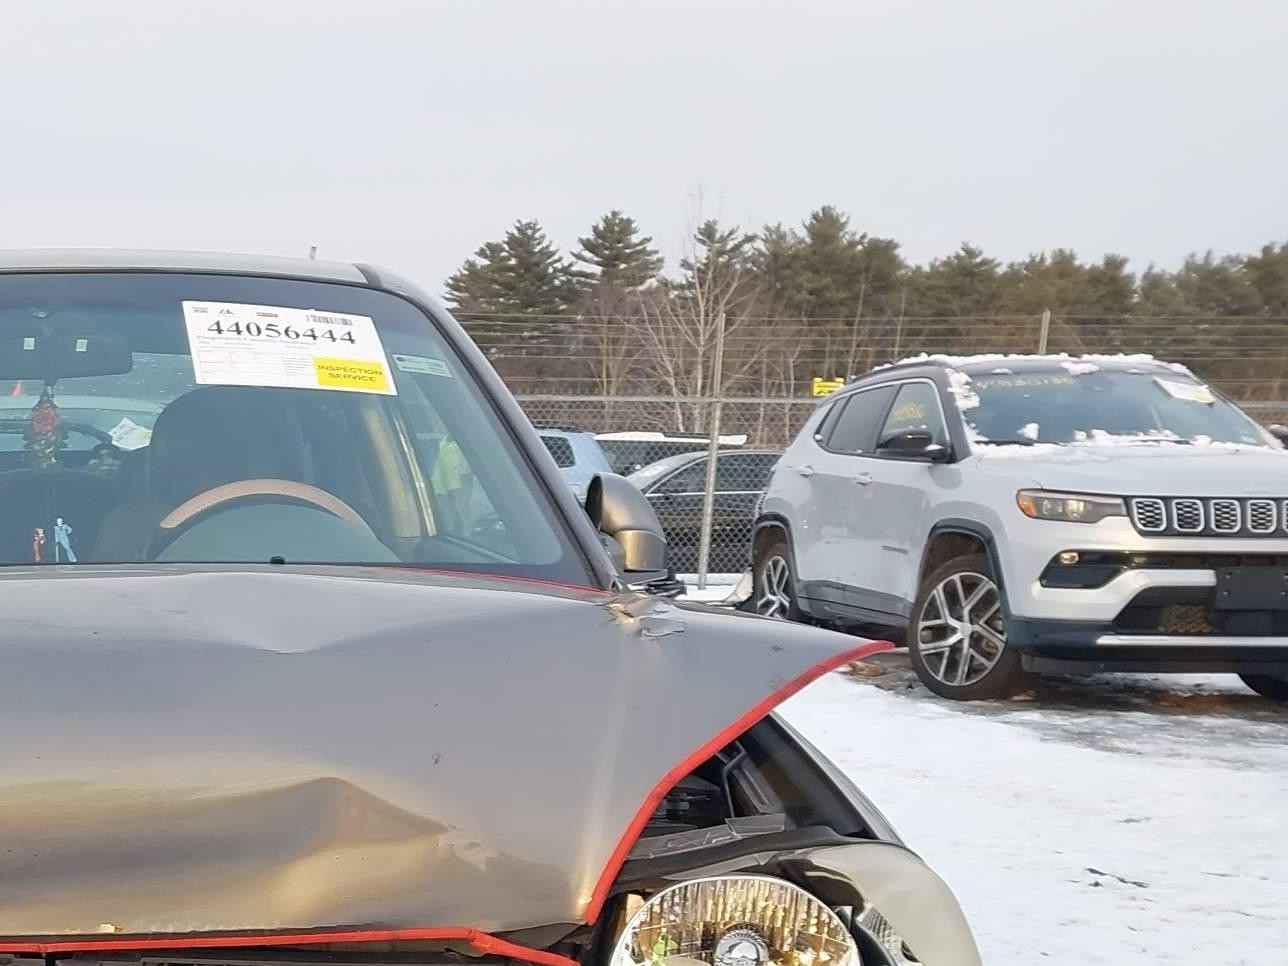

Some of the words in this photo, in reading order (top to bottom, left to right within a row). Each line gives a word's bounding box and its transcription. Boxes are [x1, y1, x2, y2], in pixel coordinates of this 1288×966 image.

[207, 319, 357, 345] 44056444
[317, 364, 384, 376] INSPECTION
[328, 372, 377, 383] SERVICE
